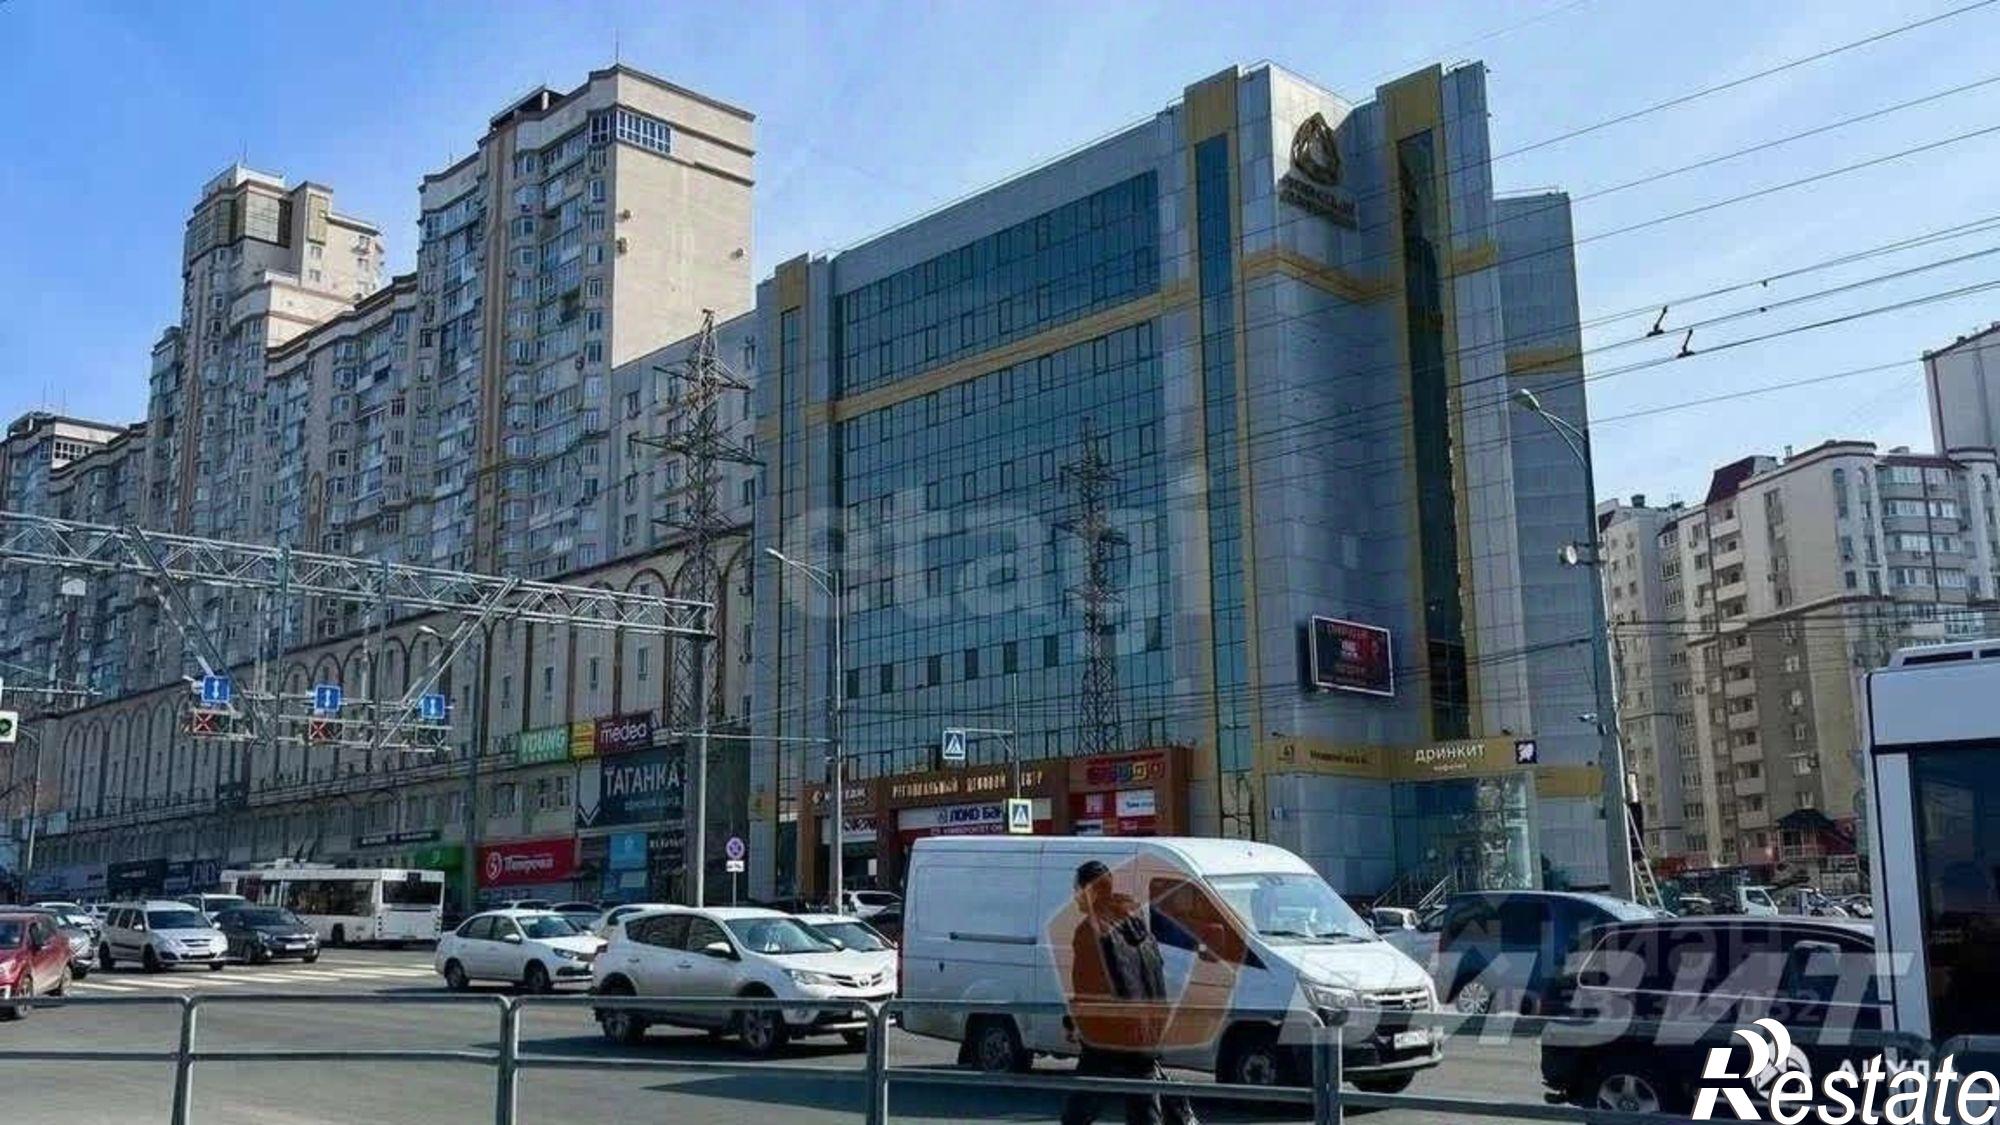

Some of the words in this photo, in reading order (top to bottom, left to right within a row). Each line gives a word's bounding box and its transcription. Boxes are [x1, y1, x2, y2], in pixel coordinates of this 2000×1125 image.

[521, 728, 566, 754] YOUNG
[600, 720, 647, 744] medea
[1415, 744, 1485, 764] ДРИНКИТ
[605, 762, 680, 799] ТАГАНКА
